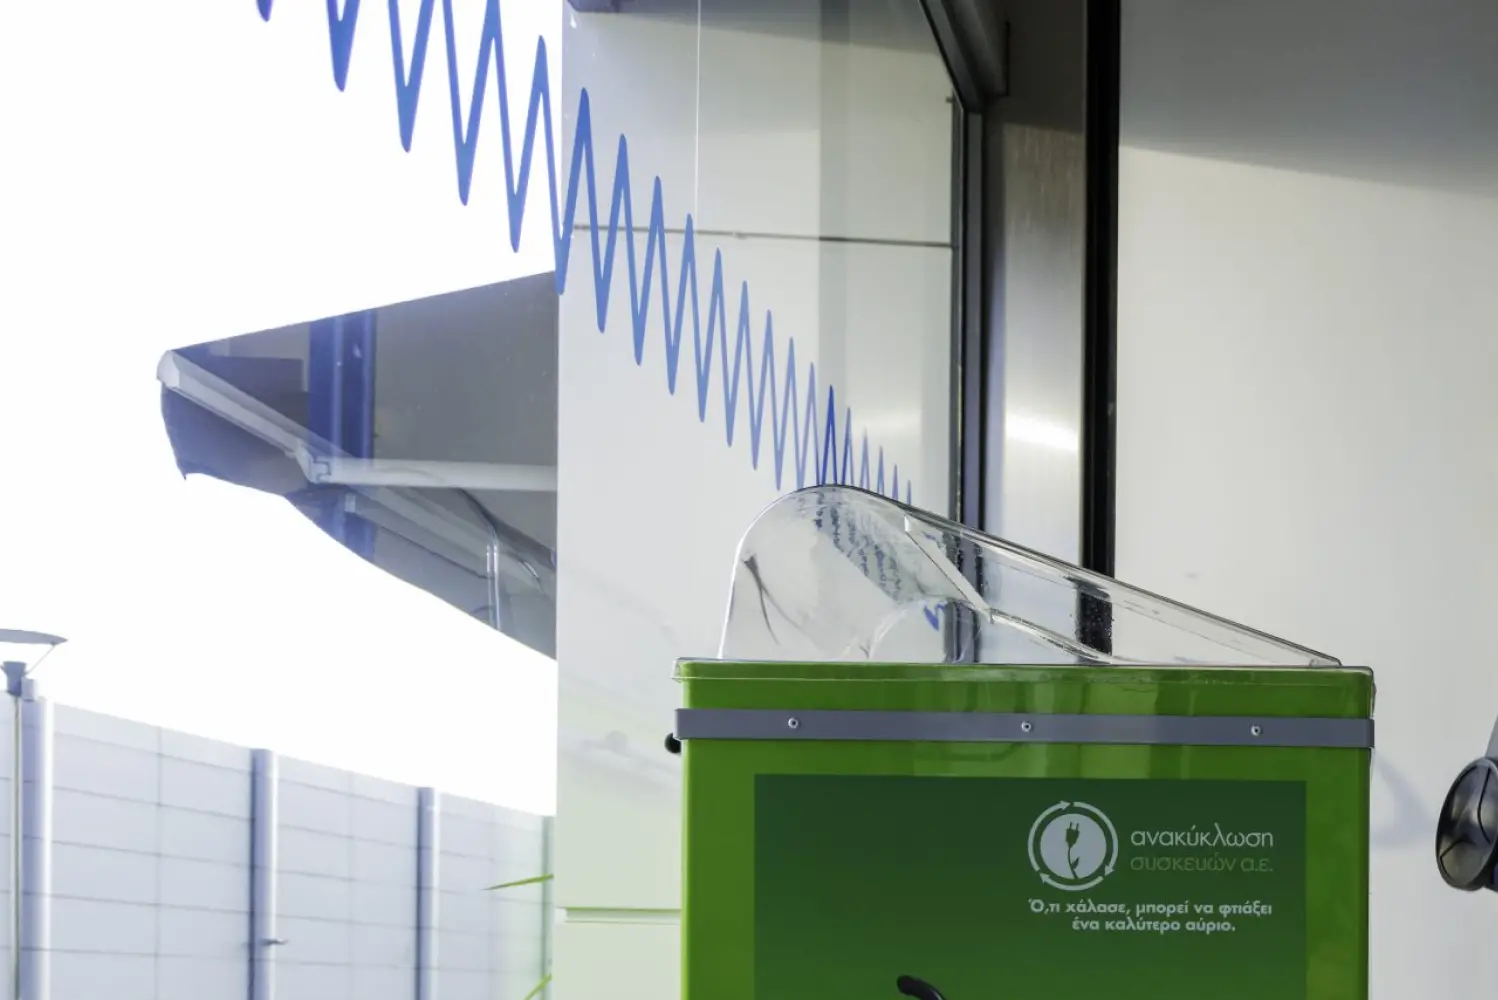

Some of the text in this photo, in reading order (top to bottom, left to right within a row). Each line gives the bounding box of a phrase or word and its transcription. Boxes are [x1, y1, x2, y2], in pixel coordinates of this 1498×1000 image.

[1130, 822, 1274, 848] ανακύκλωση
[1130, 852, 1274, 873] συσκευών α.ε.
[1065, 898, 1131, 916] χάλασε,
[1136, 900, 1189, 918] μπορεί
[1193, 904, 1214, 915] να
[1218, 900, 1273, 918] φτιάξει
[1072, 916, 1236, 935] ένα καλύτερο αύριο.
